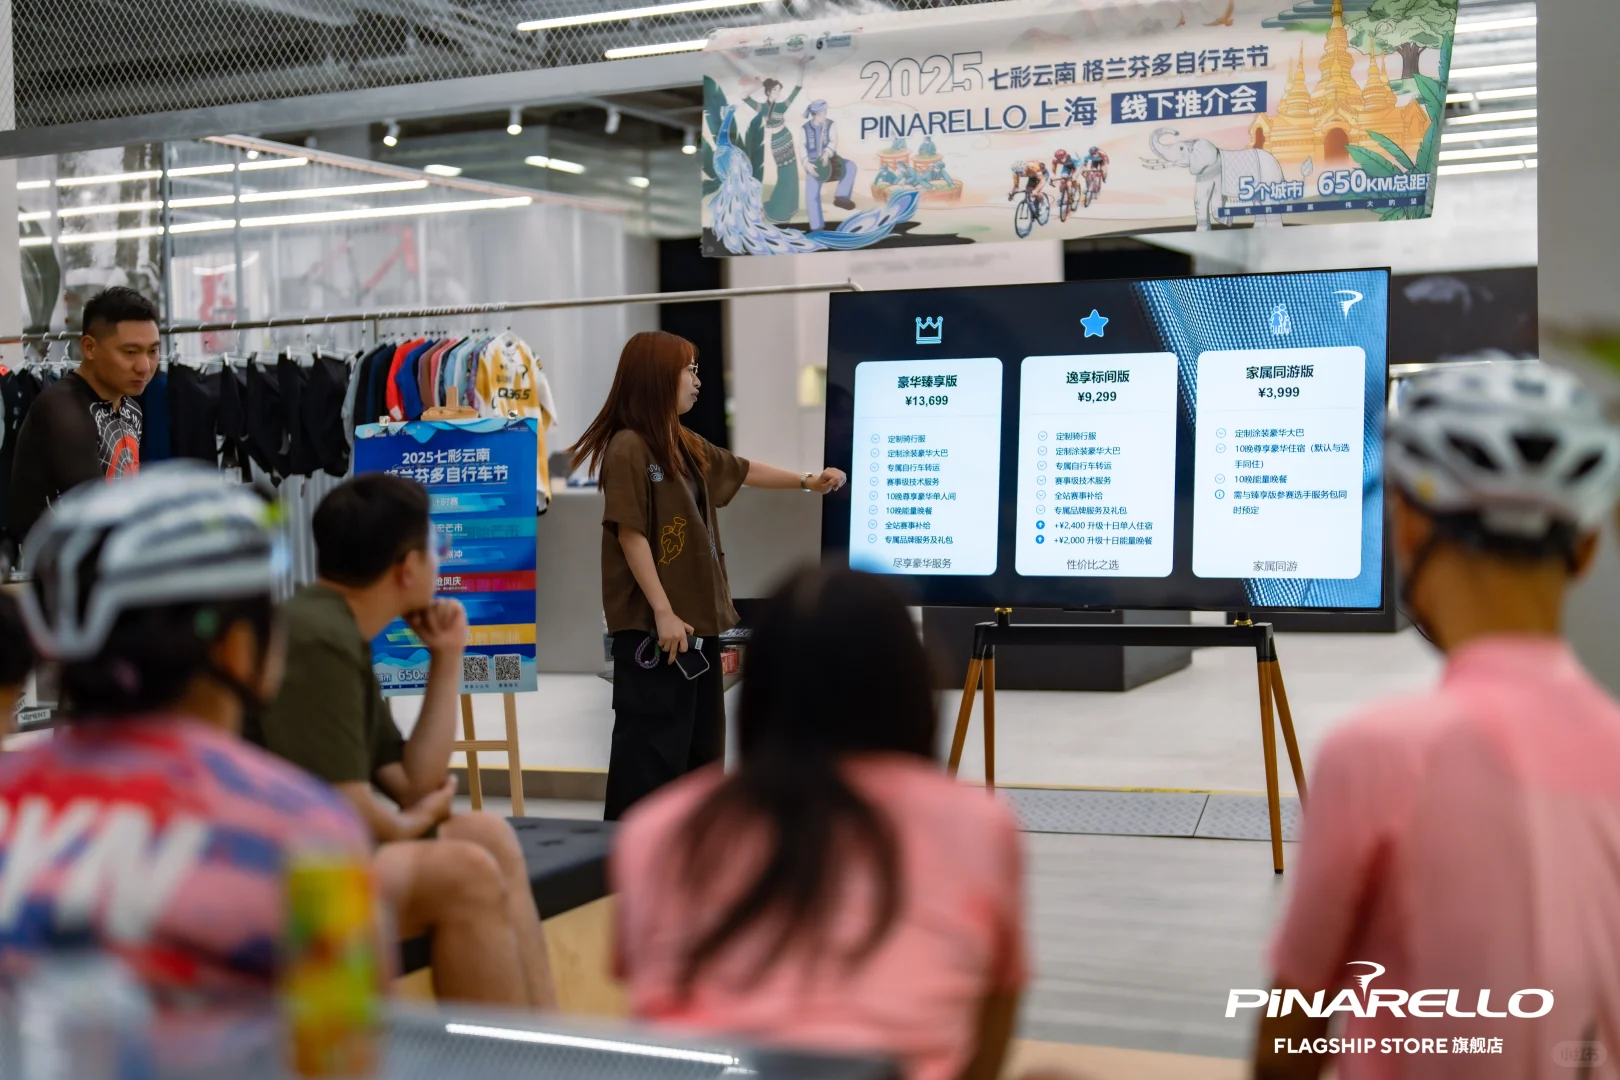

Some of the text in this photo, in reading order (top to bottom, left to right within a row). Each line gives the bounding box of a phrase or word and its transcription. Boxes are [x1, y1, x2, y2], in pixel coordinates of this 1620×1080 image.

[860, 45, 1268, 99] 2025 七彩云南 格兰芬多自行车节
[1121, 85, 1257, 121] 线下推介会
[1239, 176, 1303, 199] 5个城市
[1246, 365, 1314, 379] 家属同游版
[898, 375, 957, 388] 豪华臻享版
[1066, 370, 1130, 384] 逸享标间版
[1078, 392, 1117, 403] ¥9,299
[1258, 387, 1299, 399] ¥3,999
[905, 396, 948, 407] ¥13,699
[1056, 432, 1096, 441] 定制骑行服
[1235, 429, 1304, 438] 定制涂装豪华大巴
[888, 435, 926, 443] 定制骑行服
[888, 449, 948, 458] 定制涂装豪华大巴
[1056, 447, 1121, 455] 定制涂装豪华大巴
[402, 448, 490, 464] 2025七彩云南
[887, 463, 940, 472] 专属自行车转运
[1056, 461, 1112, 470] 专属自行车转运
[887, 478, 939, 486] 赛事级技术服务
[1055, 476, 1111, 485] 赛事级技术服务
[1235, 475, 1287, 484] 10晚能量晚餐
[887, 492, 956, 501] 10晚尊享豪华单人间
[1055, 491, 1103, 500] 全站赛事补给
[886, 507, 932, 515] 10晚能量晚餐
[1055, 506, 1127, 515] 专属品牌服务及礼包
[1233, 506, 1259, 515] 时预定
[885, 521, 930, 530] 全站赛事补给
[1088, 521, 1153, 530] 升级十日单人住宿
[885, 536, 953, 544] 专属品牌服务及礼包
[1087, 536, 1152, 545] 升级十日能量晚餐
[893, 558, 951, 569] 尽享豪华服务
[1067, 560, 1119, 570] 性价比之选
[1253, 561, 1298, 572] 家属同游
